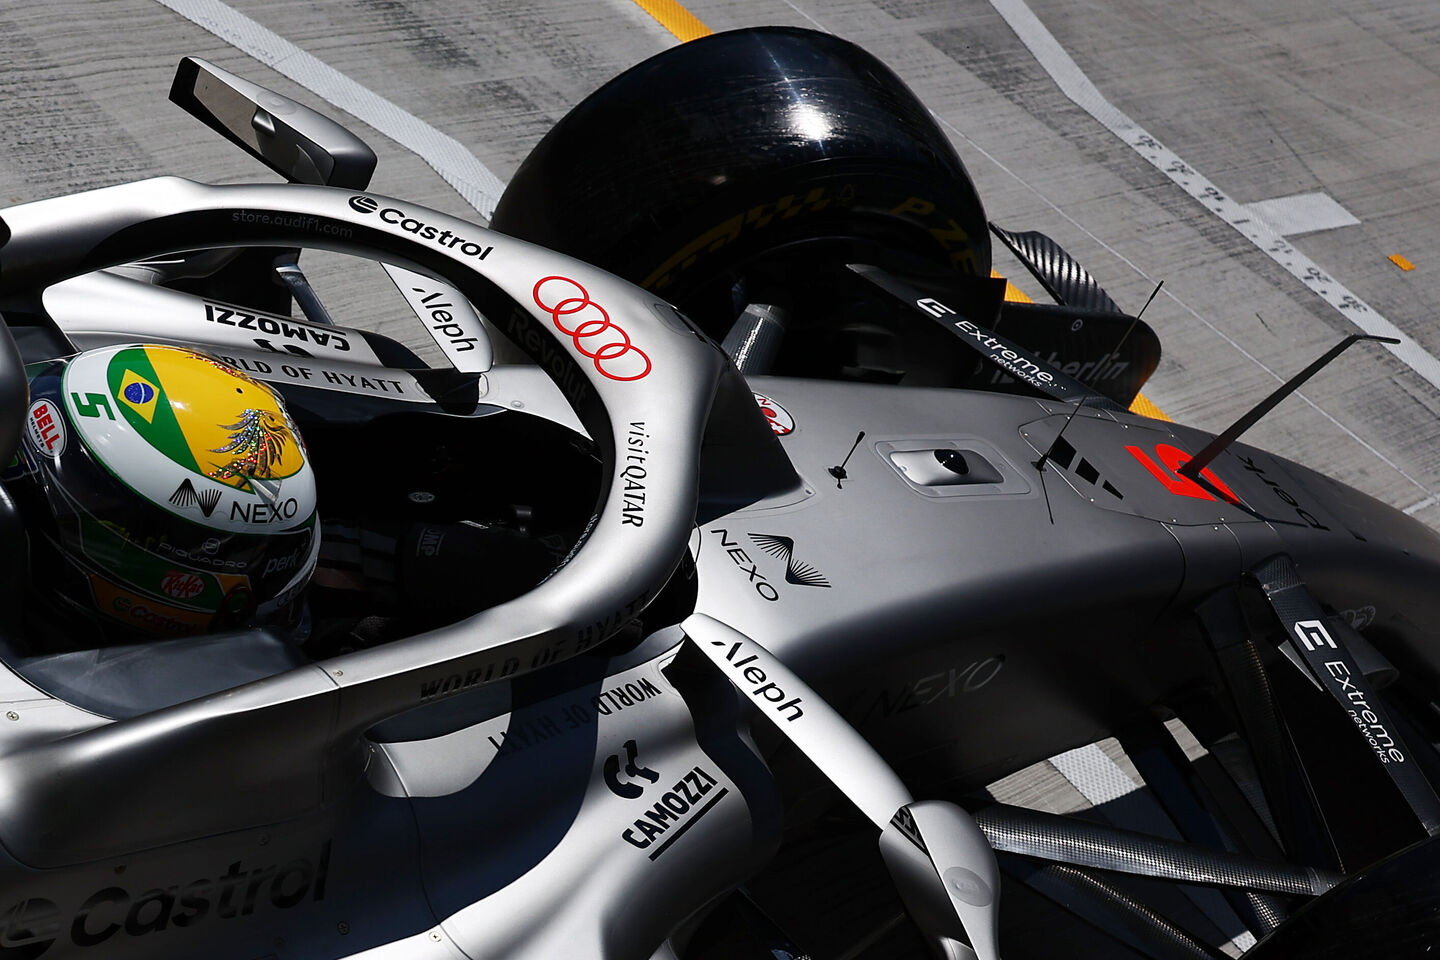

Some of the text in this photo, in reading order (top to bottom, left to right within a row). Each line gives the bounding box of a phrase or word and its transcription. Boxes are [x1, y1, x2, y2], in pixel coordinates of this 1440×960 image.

[231, 209, 353, 240] store.audif1.com
[378, 206, 494, 261] Castrol
[204, 304, 351, 352] CAMOZZI
[411, 284, 480, 353] Aleph
[221, 355, 404, 394] RLD OF HYATT
[954, 320, 1055, 384] Extreme
[989, 353, 1043, 388] networks
[33, 404, 60, 451] BELL
[70, 392, 117, 421] 5
[621, 420, 648, 528] visitQATAR
[230, 497, 299, 525] NEXO
[710, 528, 779, 602] NEXO
[420, 589, 650, 699] WORLD OF HYATT
[591, 677, 662, 716] WORLD
[711, 640, 804, 722] Aleph
[859, 653, 1006, 728] NEXO
[565, 703, 591, 729] OF
[1323, 660, 1405, 764] Extreme
[1347, 709, 1391, 765] networks
[621, 766, 718, 851] CAMOZZI
[69, 838, 333, 948] Castrol
